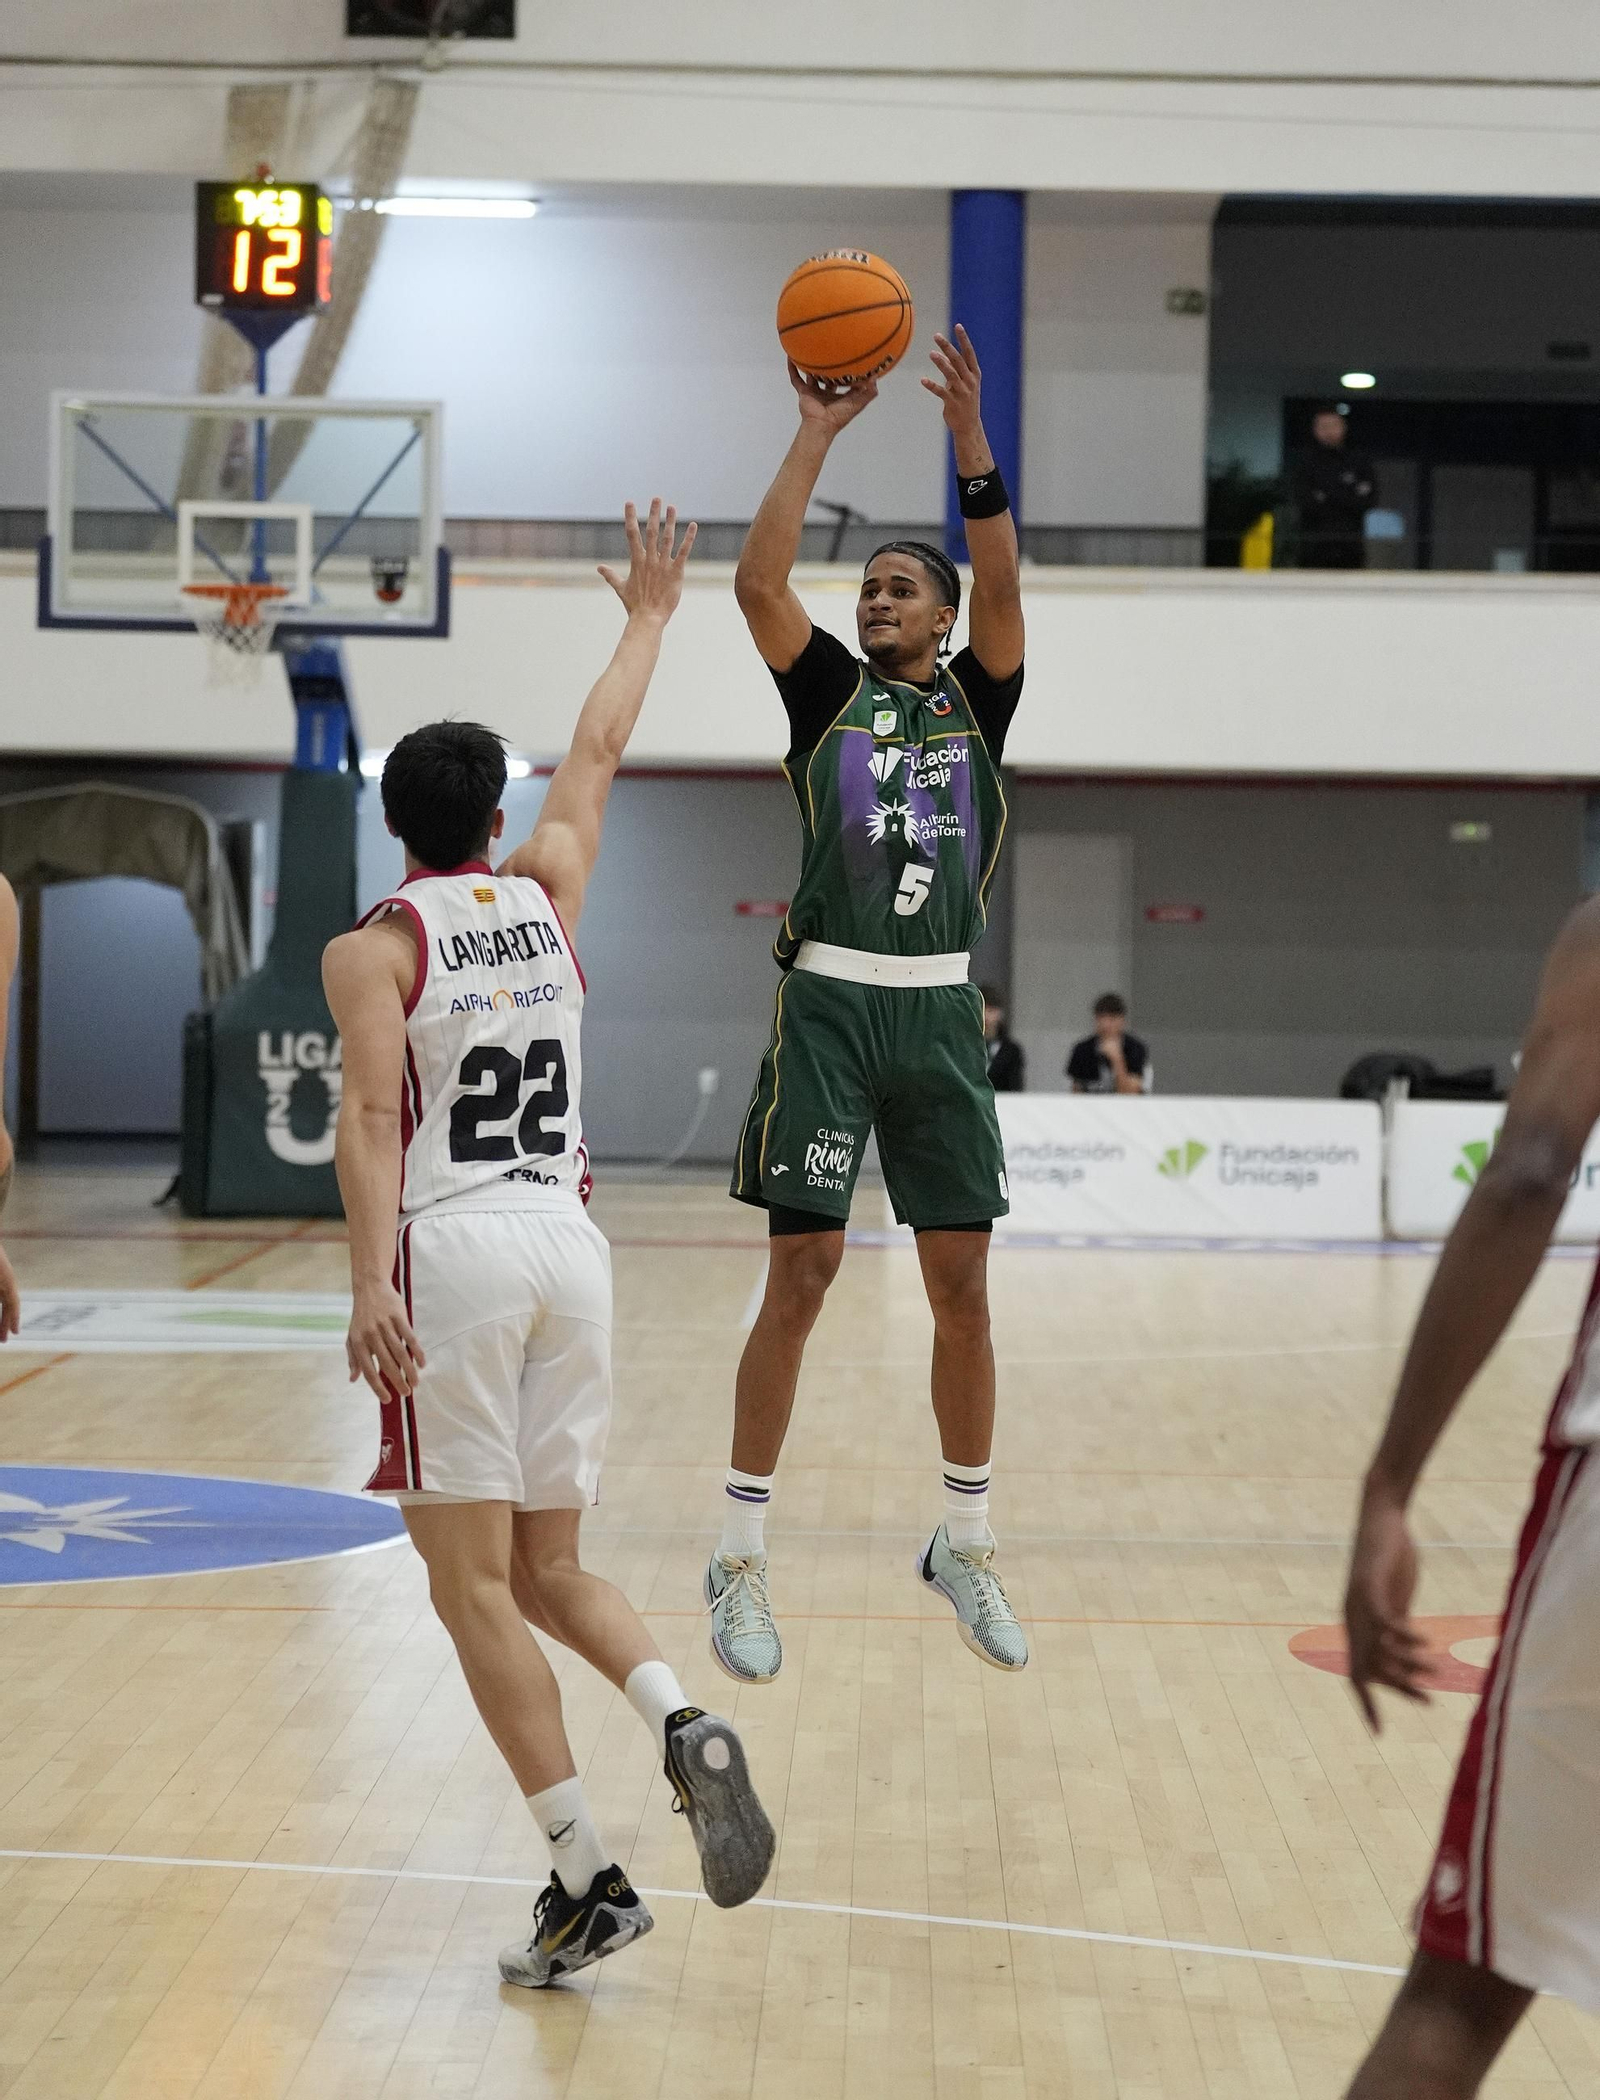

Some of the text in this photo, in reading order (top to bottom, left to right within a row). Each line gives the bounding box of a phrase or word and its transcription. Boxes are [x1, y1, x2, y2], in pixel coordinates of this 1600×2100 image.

[233, 228, 302, 295] 12
[924, 691, 947, 708] LIGA
[893, 861, 935, 916] 5
[438, 921, 563, 972] LANGARITA
[449, 1039, 570, 1163] 22
[1004, 1142, 1125, 1163] undación
[1219, 1141, 1360, 1165] Fundación
[806, 1174, 846, 1192] DENTA
[1008, 1164, 1086, 1189] nicaja
[1219, 1165, 1319, 1191] Unicaja
